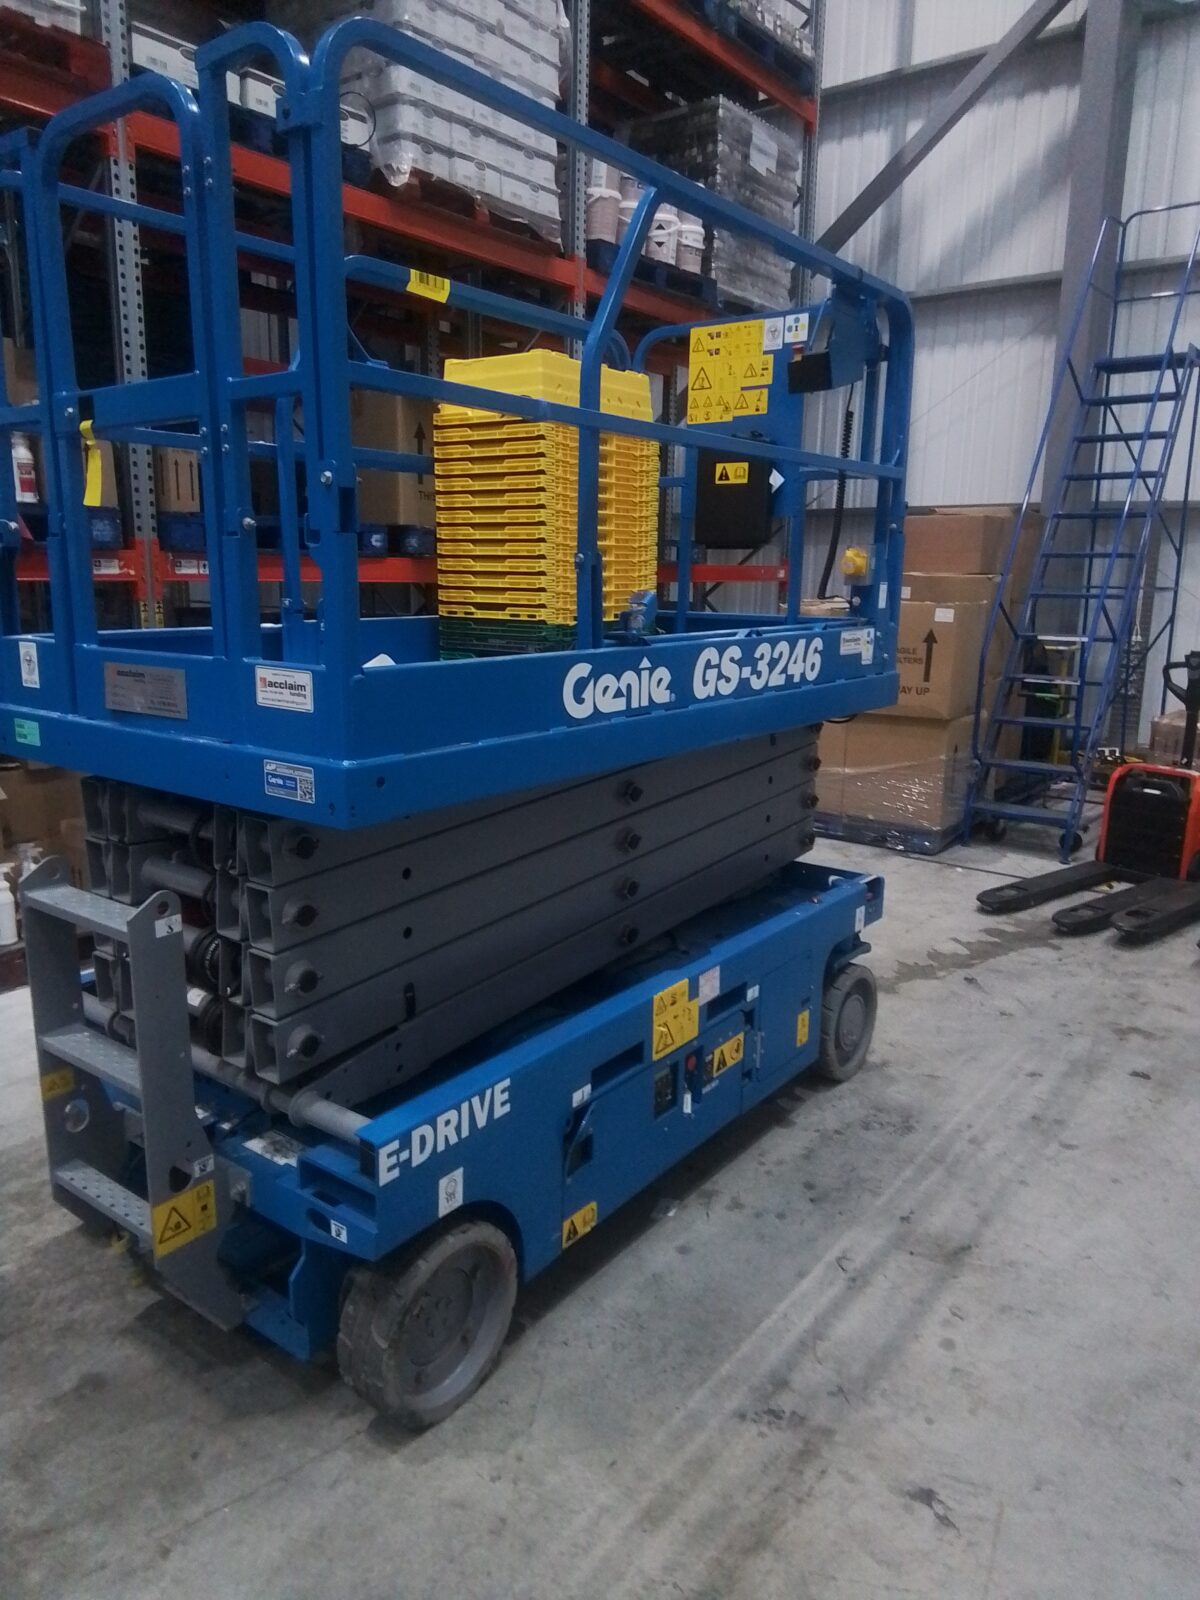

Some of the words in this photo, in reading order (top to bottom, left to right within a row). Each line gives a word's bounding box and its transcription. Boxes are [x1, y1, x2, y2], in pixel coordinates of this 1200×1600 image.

[267, 679, 307, 692] acclaim
[563, 656, 672, 719] Genie
[692, 637, 824, 700] GS-3246
[898, 685, 912, 695] AY
[916, 686, 930, 696] UP
[378, 1077, 511, 1188] E-DRIVE
